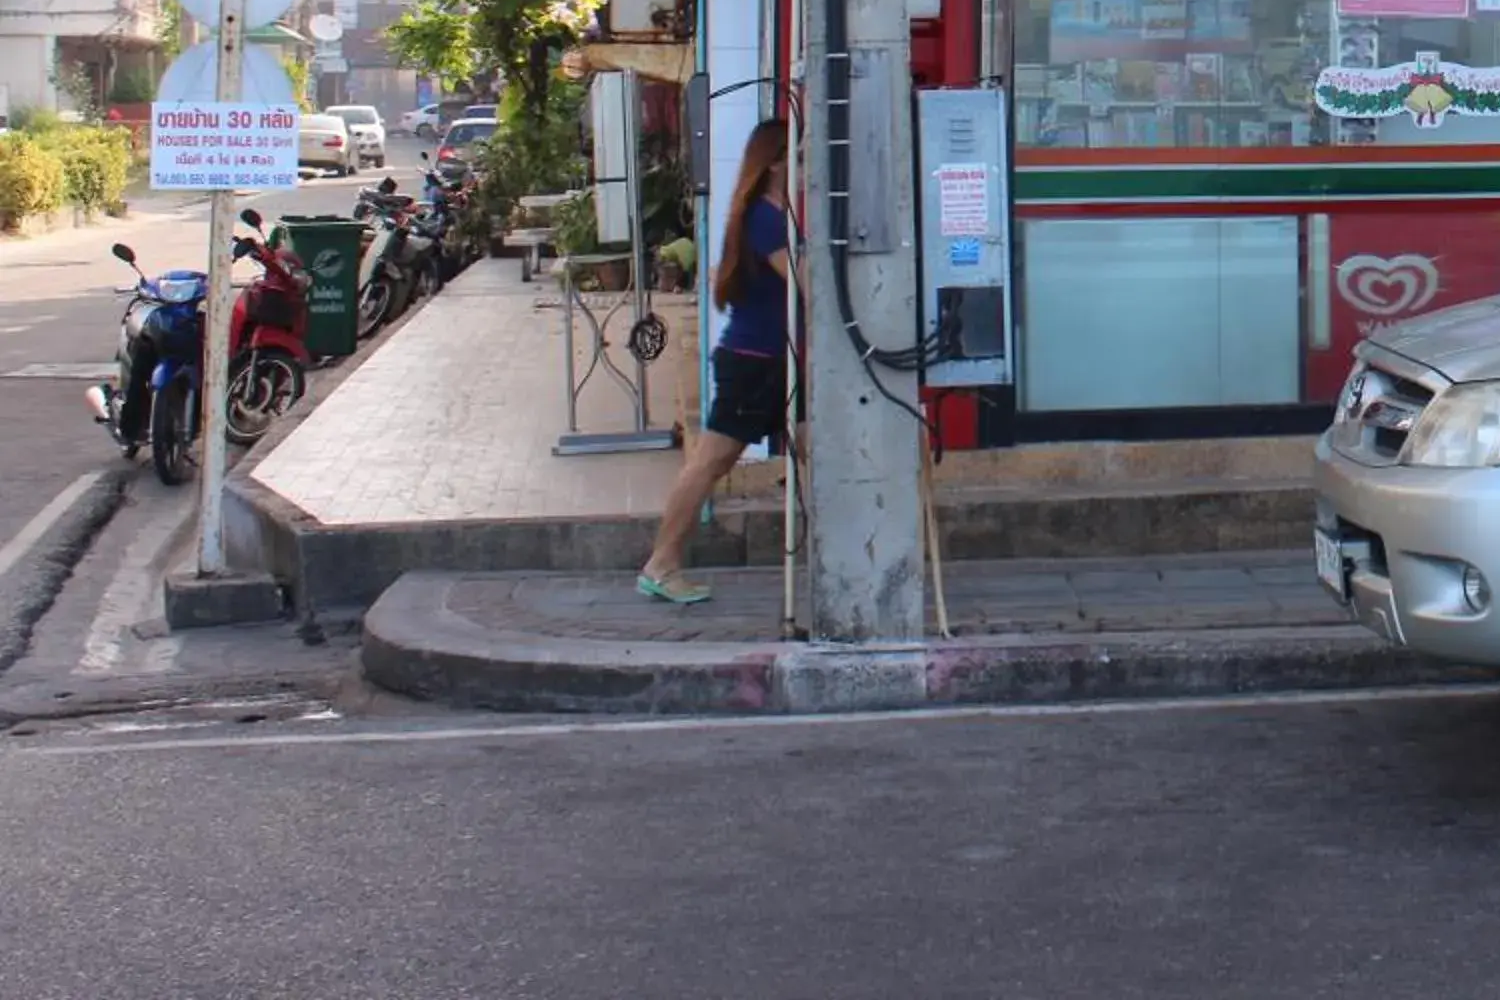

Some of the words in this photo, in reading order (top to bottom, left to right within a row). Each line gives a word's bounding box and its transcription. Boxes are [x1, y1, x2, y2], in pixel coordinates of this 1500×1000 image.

[158, 108, 219, 129] ขายบ้าน
[227, 111, 252, 129] 30
[259, 109, 293, 129] หลัง
[158, 135, 198, 147] HOUSES
[202, 136, 223, 147] FOR
[226, 136, 252, 147] SALE
